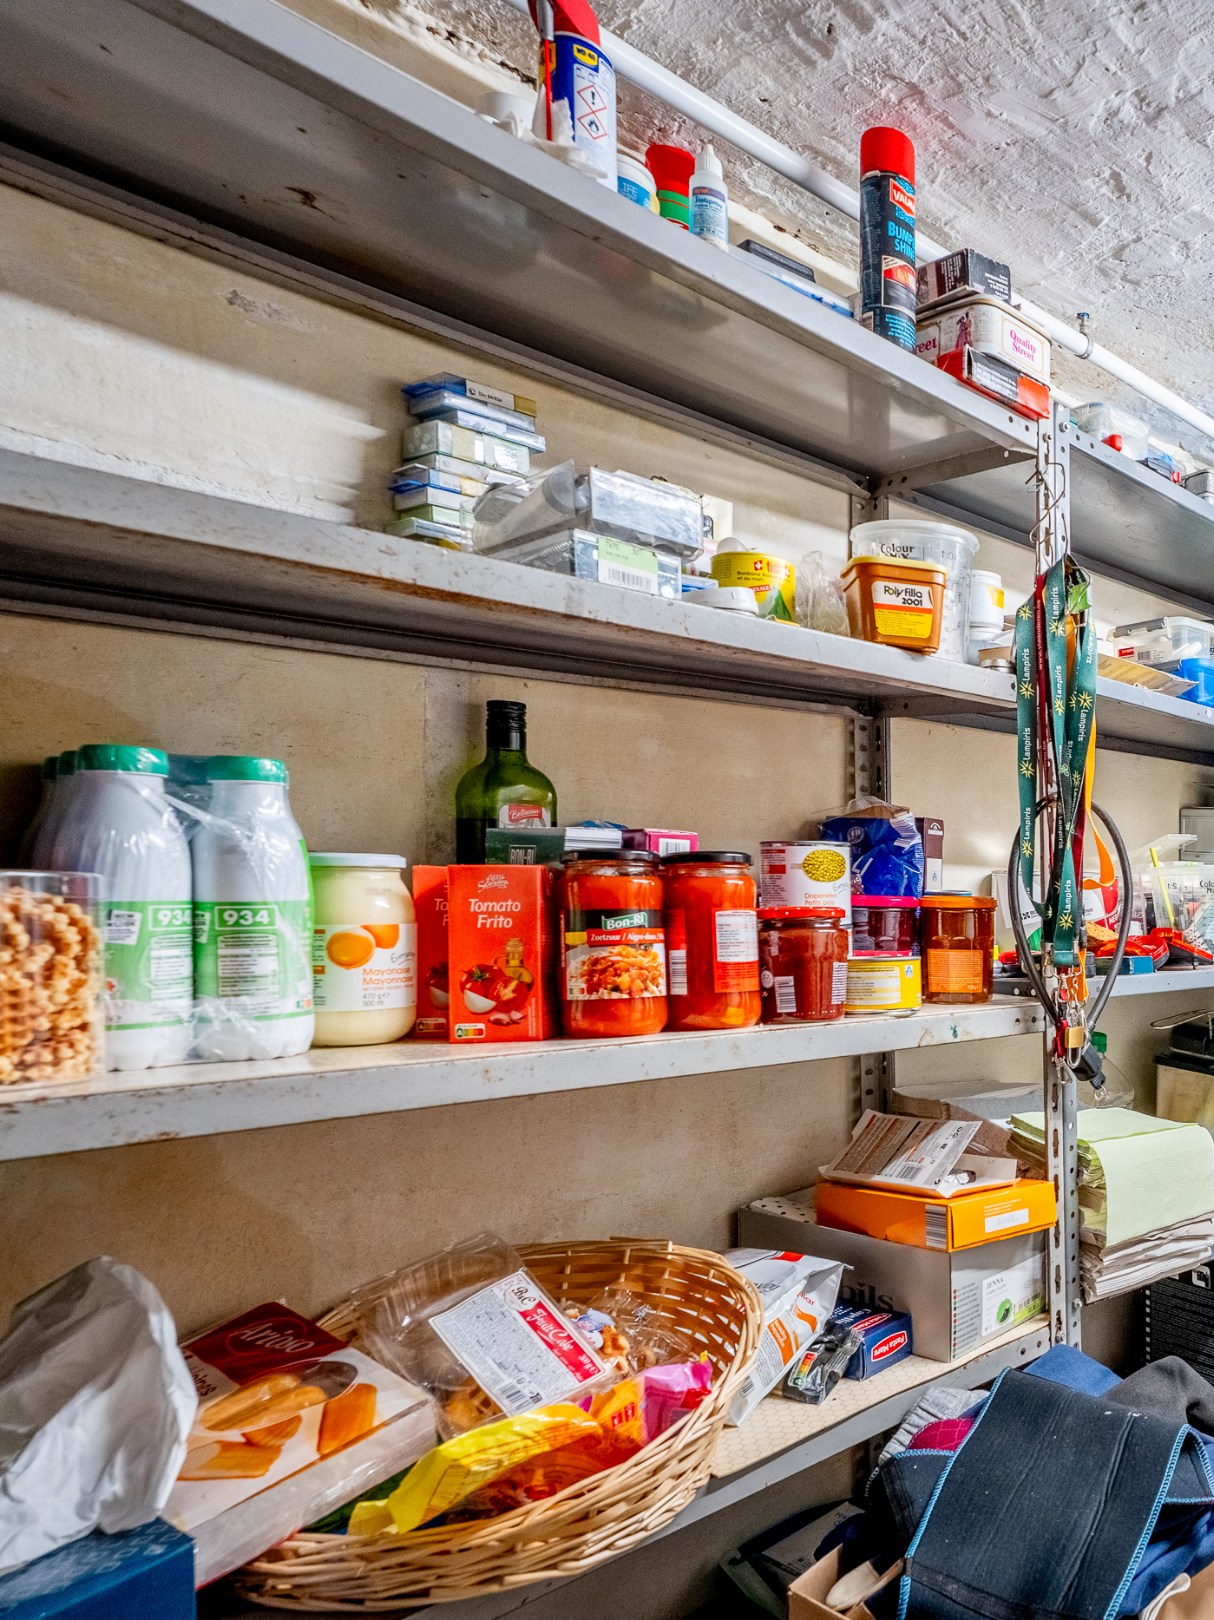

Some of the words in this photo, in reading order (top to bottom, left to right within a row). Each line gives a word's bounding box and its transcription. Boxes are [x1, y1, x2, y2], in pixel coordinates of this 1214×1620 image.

[914, 337, 937, 355] reet
[1010, 329, 1037, 354] Quality
[1012, 342, 1035, 361] Street
[881, 543, 915, 554] Colour
[902, 597, 923, 607] 2001
[1052, 586, 1060, 621] Lampiris
[1022, 648, 1031, 682] Lampiris
[1078, 708, 1089, 743] Lampiris
[1022, 727, 1031, 761] Lampiris
[1063, 879, 1072, 913] Lampiris
[469, 899, 521, 913] Tomato
[223, 910, 271, 926] 934
[477, 914, 513, 929] Frito
[606, 914, 644, 930] Bon-Ri
[874, 1344, 889, 1356] Mare
[890, 1336, 905, 1348] Pasta
